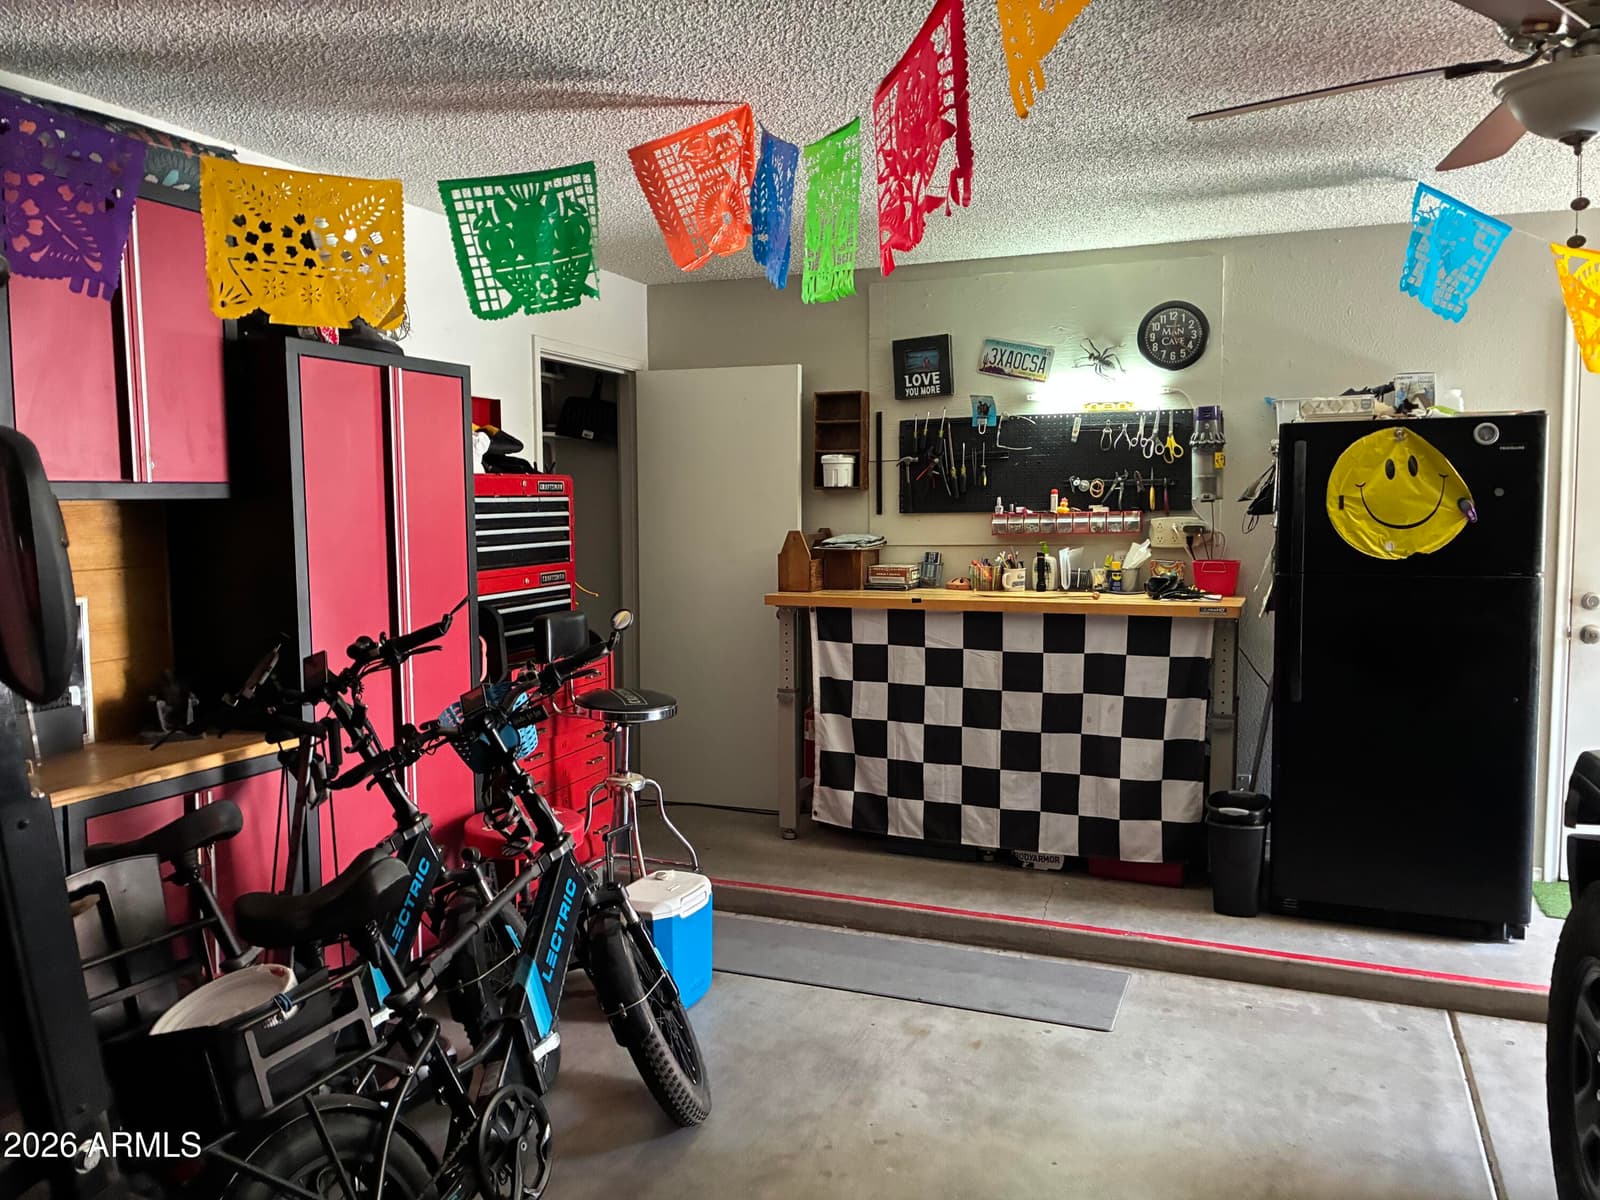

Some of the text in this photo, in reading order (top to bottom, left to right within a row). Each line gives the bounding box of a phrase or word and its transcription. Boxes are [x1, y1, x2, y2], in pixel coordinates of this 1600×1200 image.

[1160, 314, 1167, 324] 11
[1169, 311, 1178, 321] 12
[1152, 322, 1160, 331] 10
[1188, 320, 1195, 329] 2
[1162, 327, 1185, 336] MAN
[1191, 330, 1197, 339] 3
[1149, 333, 1156, 342] 9
[1161, 336, 1185, 346] CAVE
[1152, 343, 1158, 352] 8
[1187, 340, 1193, 350] 4
[1161, 350, 1167, 360] 7
[1170, 351, 1176, 360] 6
[1180, 348, 1186, 358] 5
[904, 371, 941, 388] LOVE
[904, 384, 941, 397] YOU MORE
[388, 857, 431, 956] LECTRIC
[541, 878, 577, 984] LECTRIC
